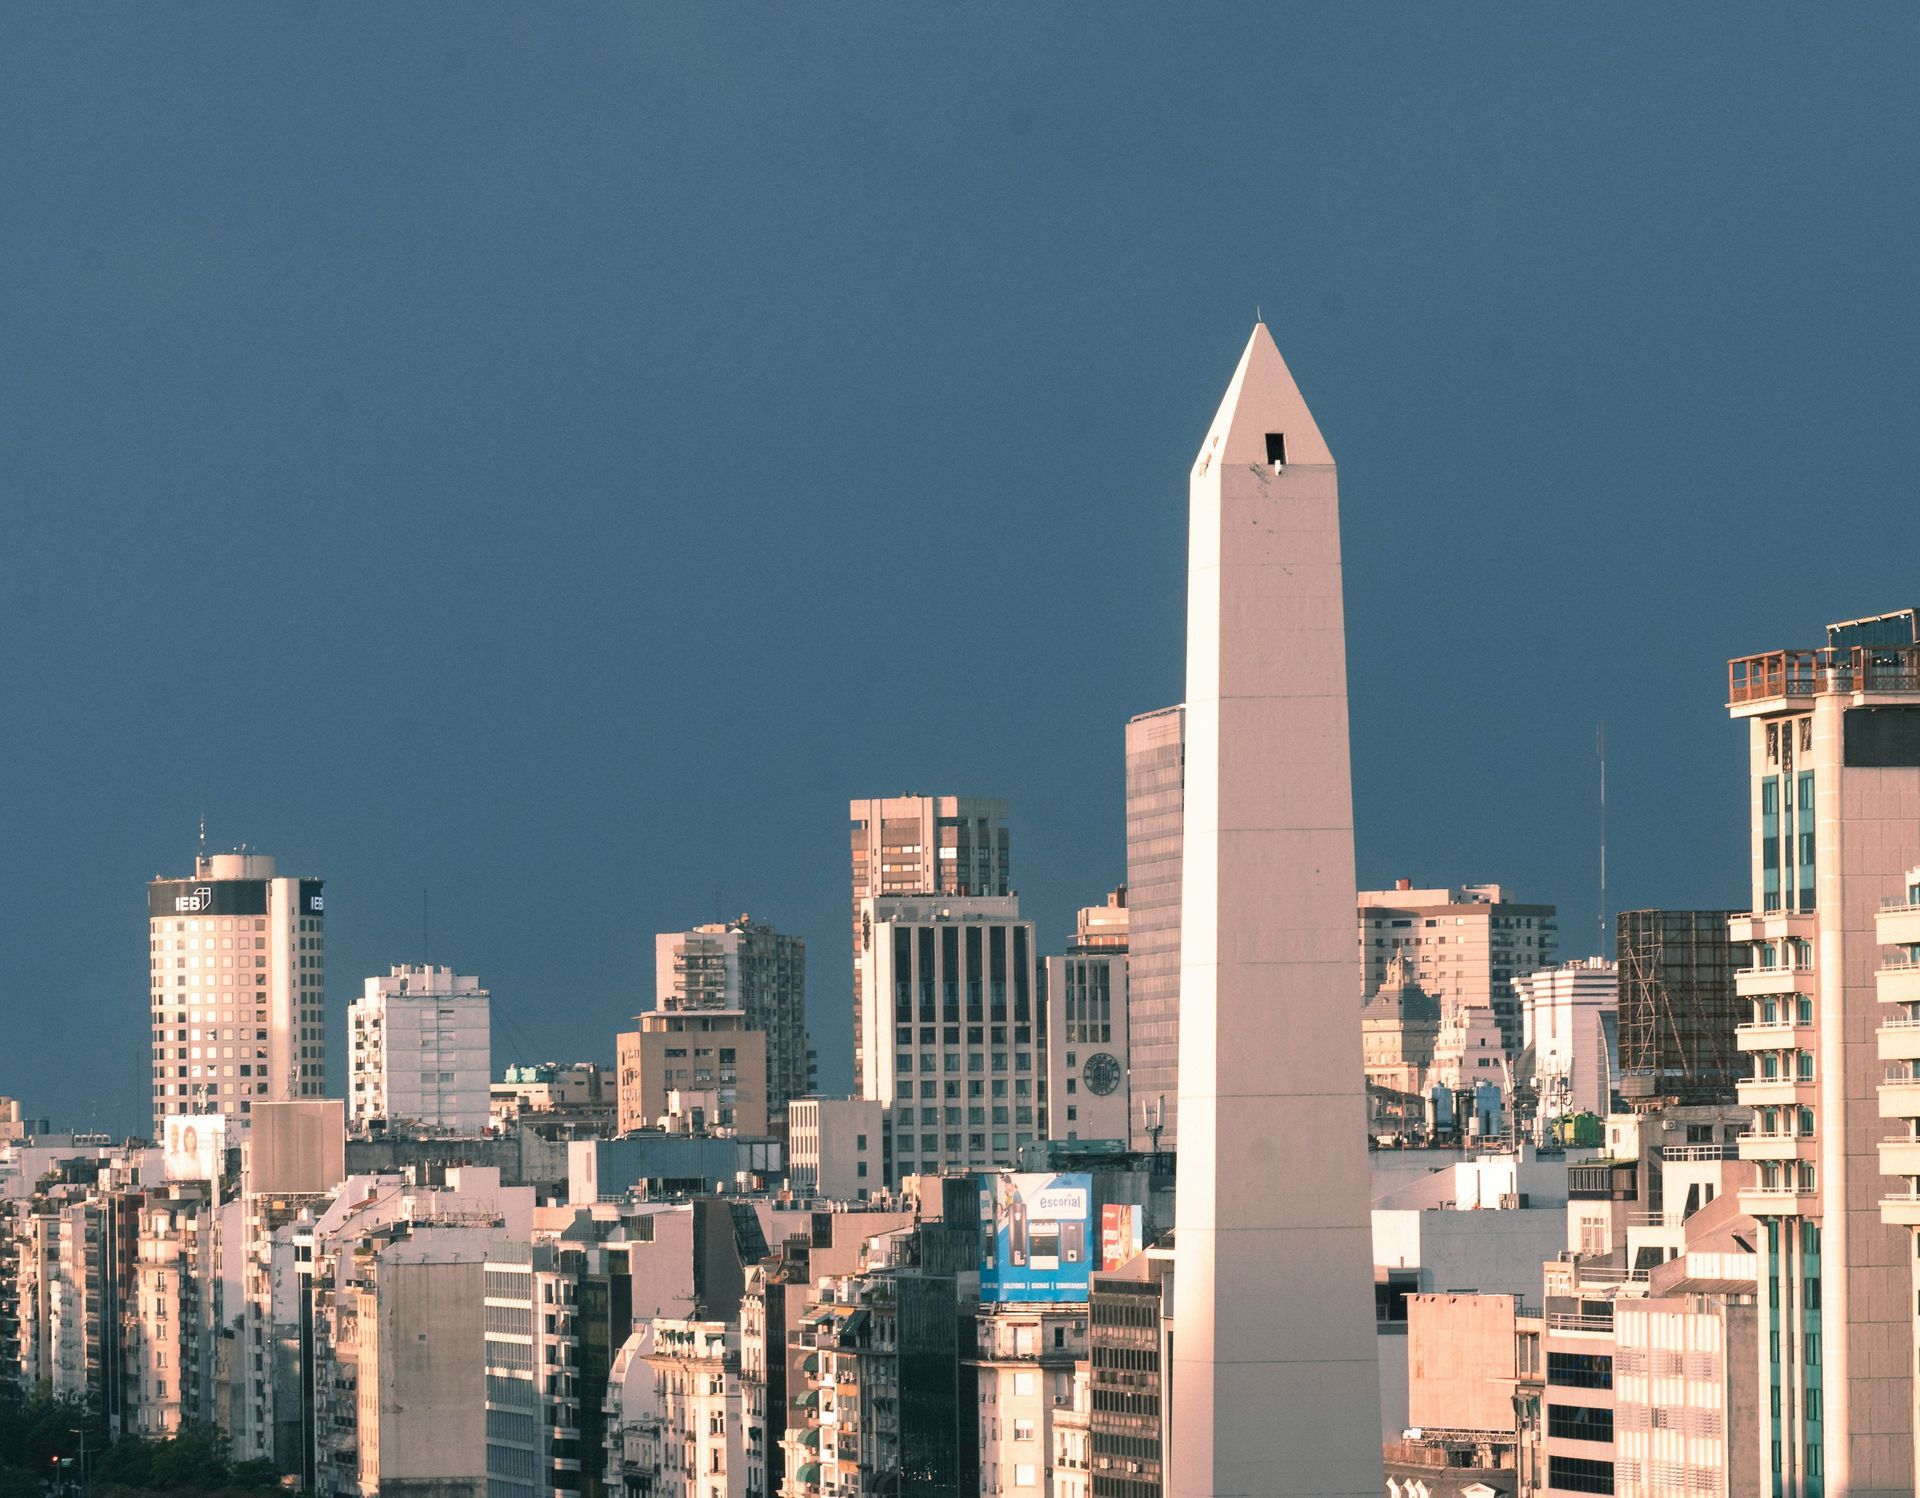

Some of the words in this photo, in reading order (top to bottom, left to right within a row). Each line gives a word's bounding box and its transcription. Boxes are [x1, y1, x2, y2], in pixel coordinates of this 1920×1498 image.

[175, 896, 201, 911] IEB
[311, 896, 324, 910] IEB
[1040, 1193, 1081, 1209] escorial
